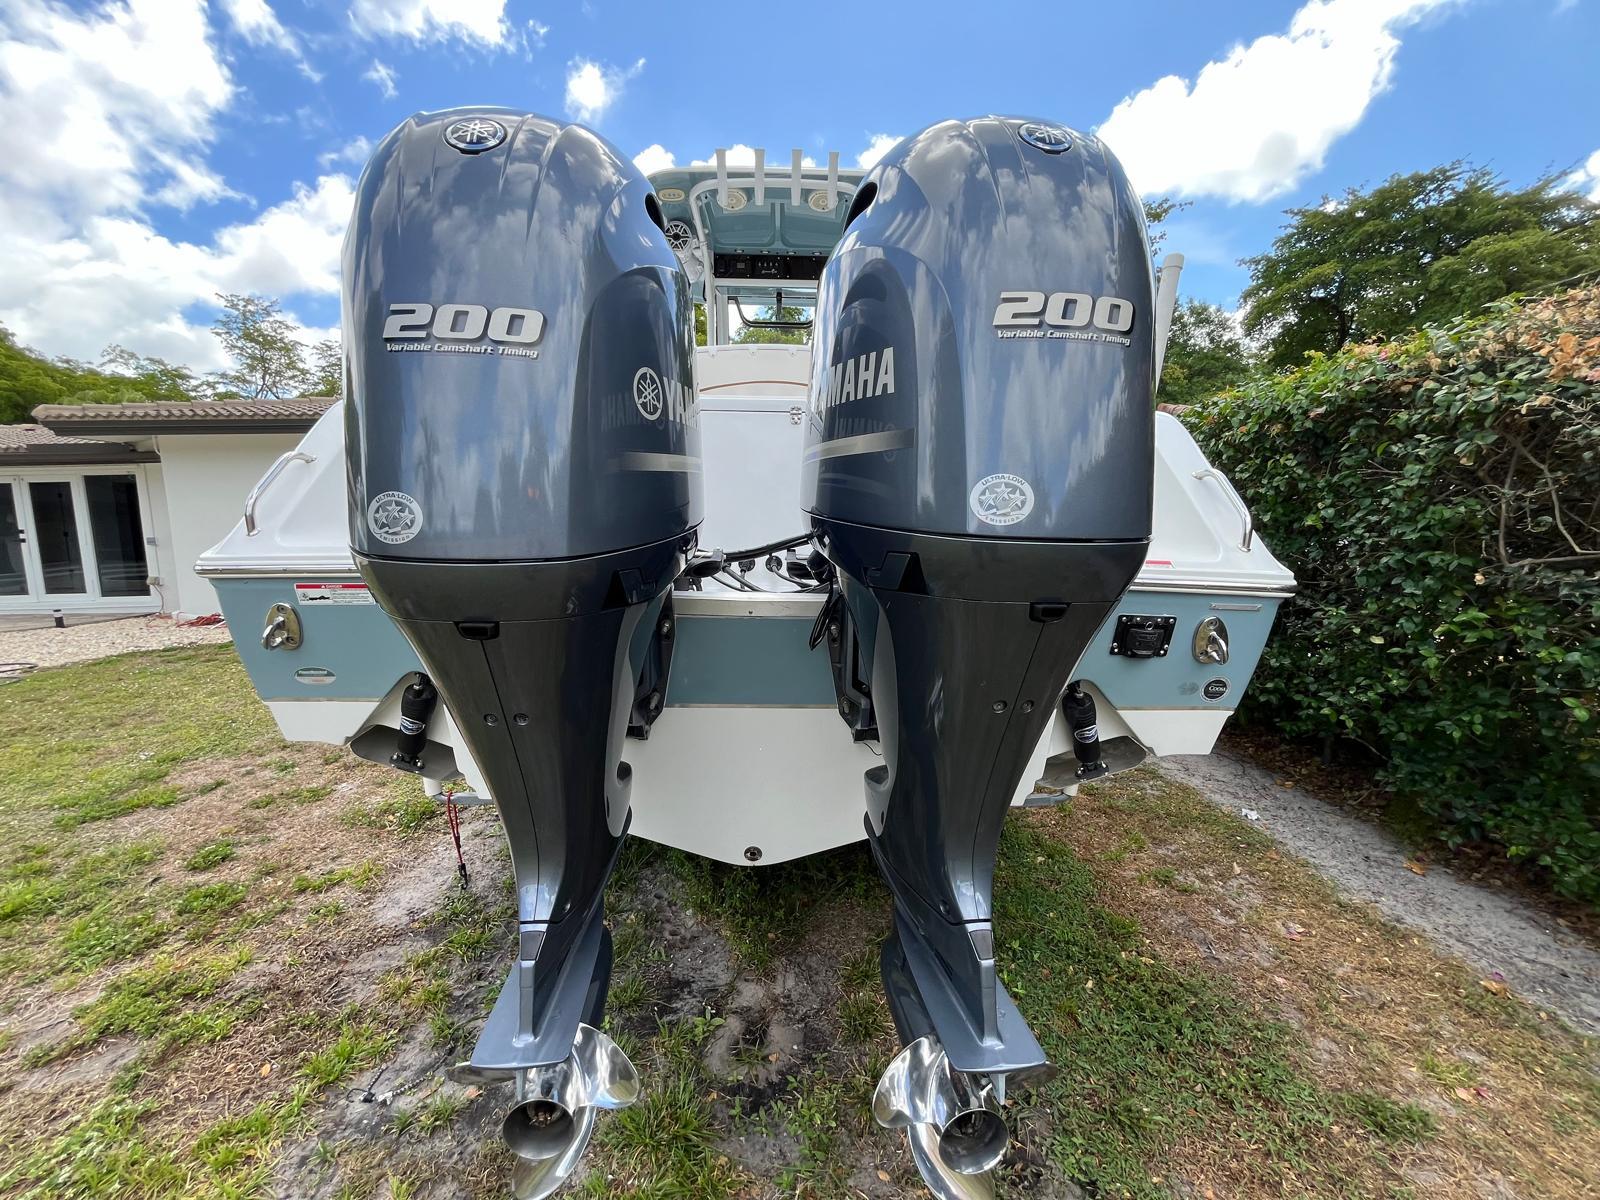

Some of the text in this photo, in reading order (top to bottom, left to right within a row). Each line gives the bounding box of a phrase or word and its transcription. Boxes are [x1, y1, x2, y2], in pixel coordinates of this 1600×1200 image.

[382, 303, 545, 344] 200
[993, 291, 1134, 332] 200
[386, 343, 538, 359] Variable Camshaft Timing
[997, 330, 1131, 346] Variable Camshaft Timing
[816, 346, 895, 412] MAHA
